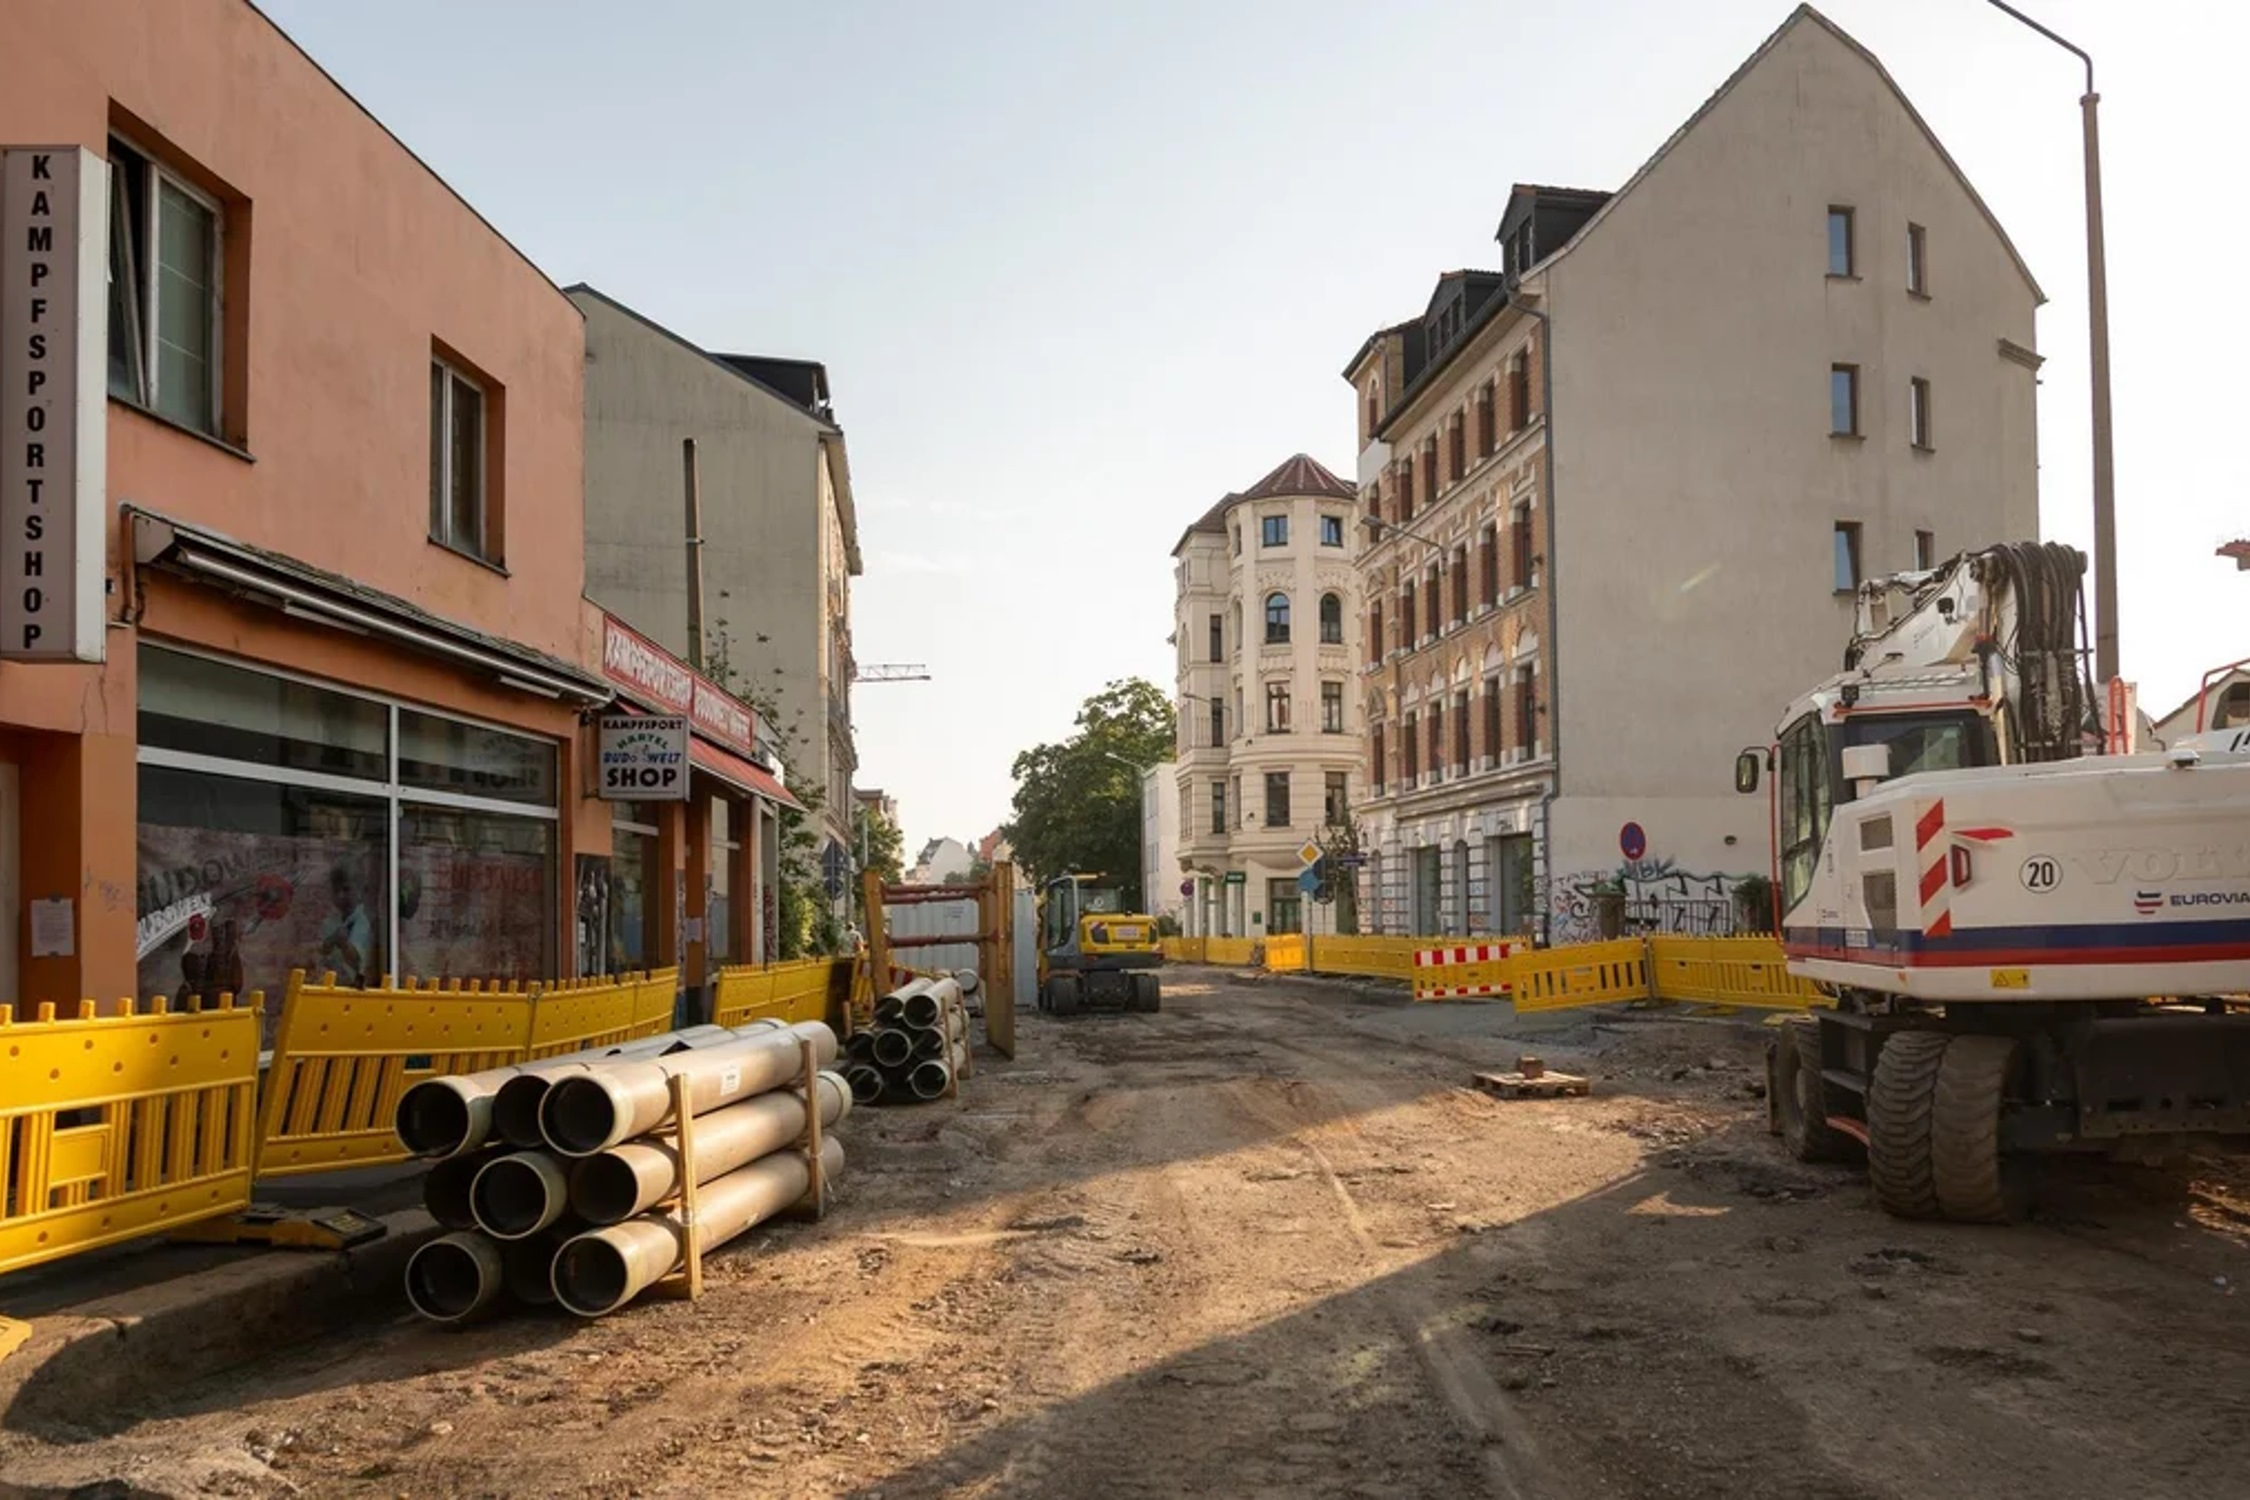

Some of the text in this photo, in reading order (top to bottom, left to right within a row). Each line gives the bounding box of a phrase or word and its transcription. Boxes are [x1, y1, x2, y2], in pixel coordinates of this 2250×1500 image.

[23, 154, 52, 650] KAMPFSPORTSHOP
[603, 720, 683, 729] KAMPFSPORT
[647, 753, 681, 763] WELT
[607, 767, 677, 787] SHOP
[2028, 862, 2054, 887] 20
[2170, 893, 2250, 907] EUROVIA
